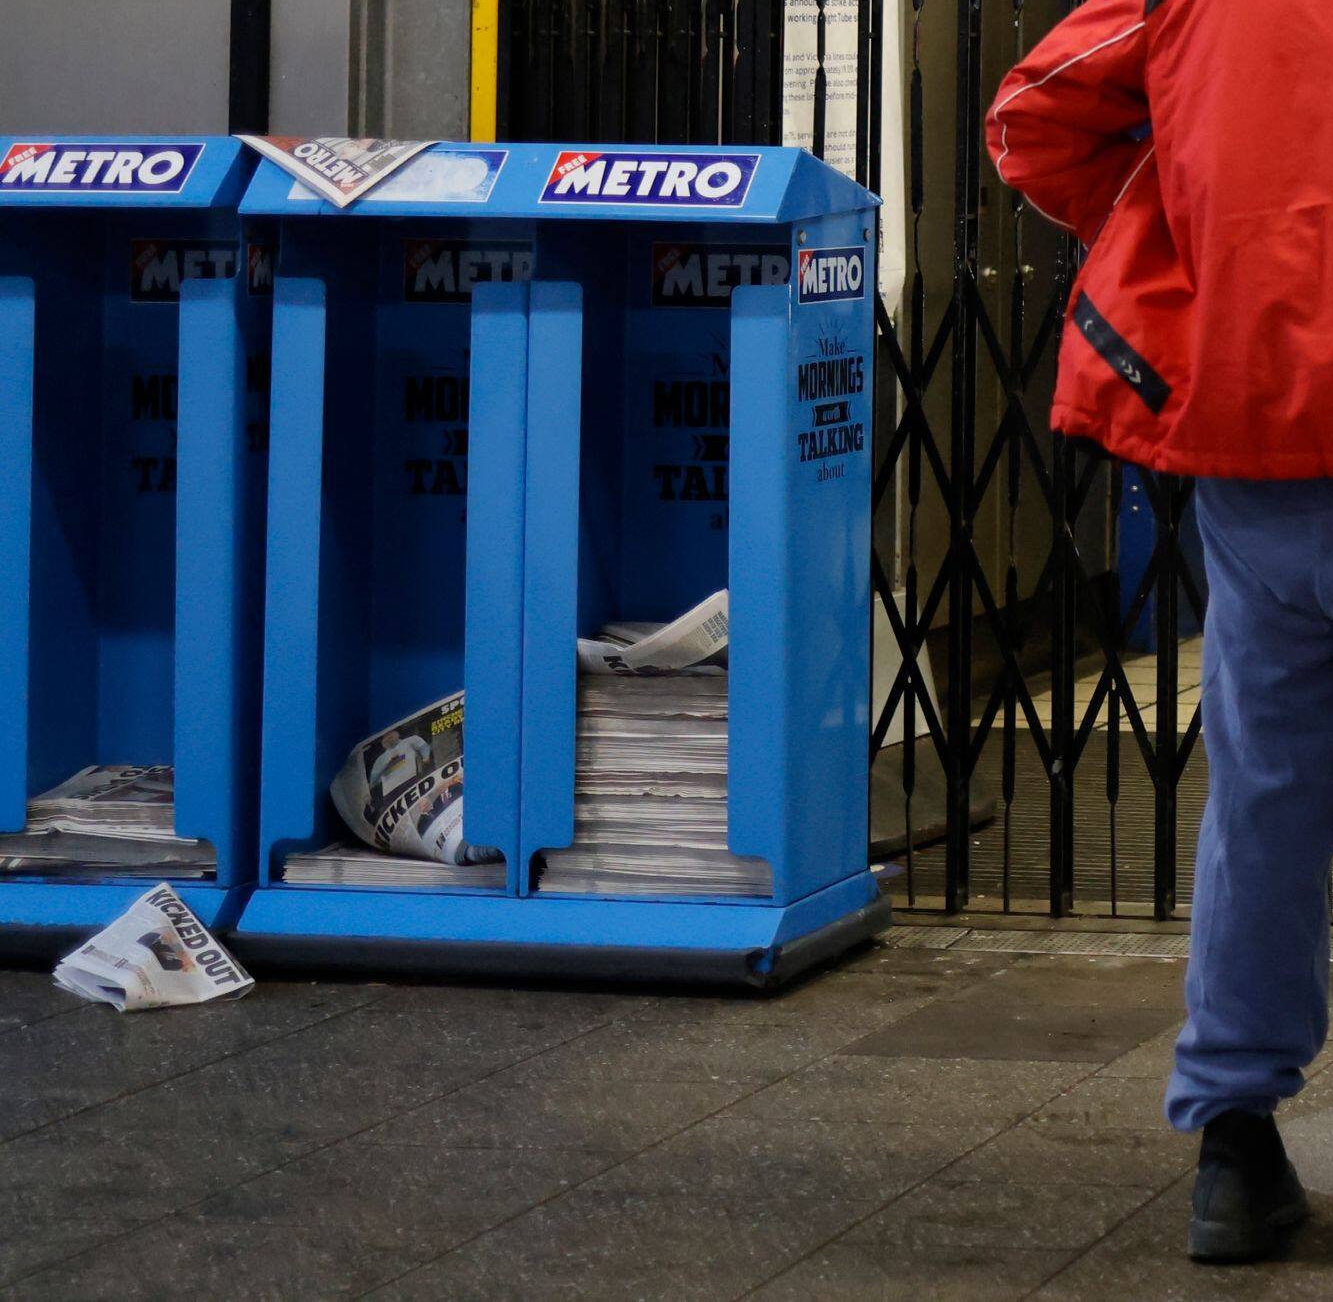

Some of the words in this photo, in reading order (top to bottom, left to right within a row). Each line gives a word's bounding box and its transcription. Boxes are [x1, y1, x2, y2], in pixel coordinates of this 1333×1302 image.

[2, 150, 185, 185] METRO
[8, 146, 38, 166] FREE
[293, 142, 368, 186] METRO
[558, 154, 587, 175] FREE
[553, 161, 743, 199] METRO
[802, 254, 863, 295] METRO
[797, 355, 864, 402] MORNINGS
[797, 422, 864, 462] TALKING
[817, 462, 845, 483] about
[145, 888, 209, 952] KICKED
[195, 949, 241, 987] OUT
